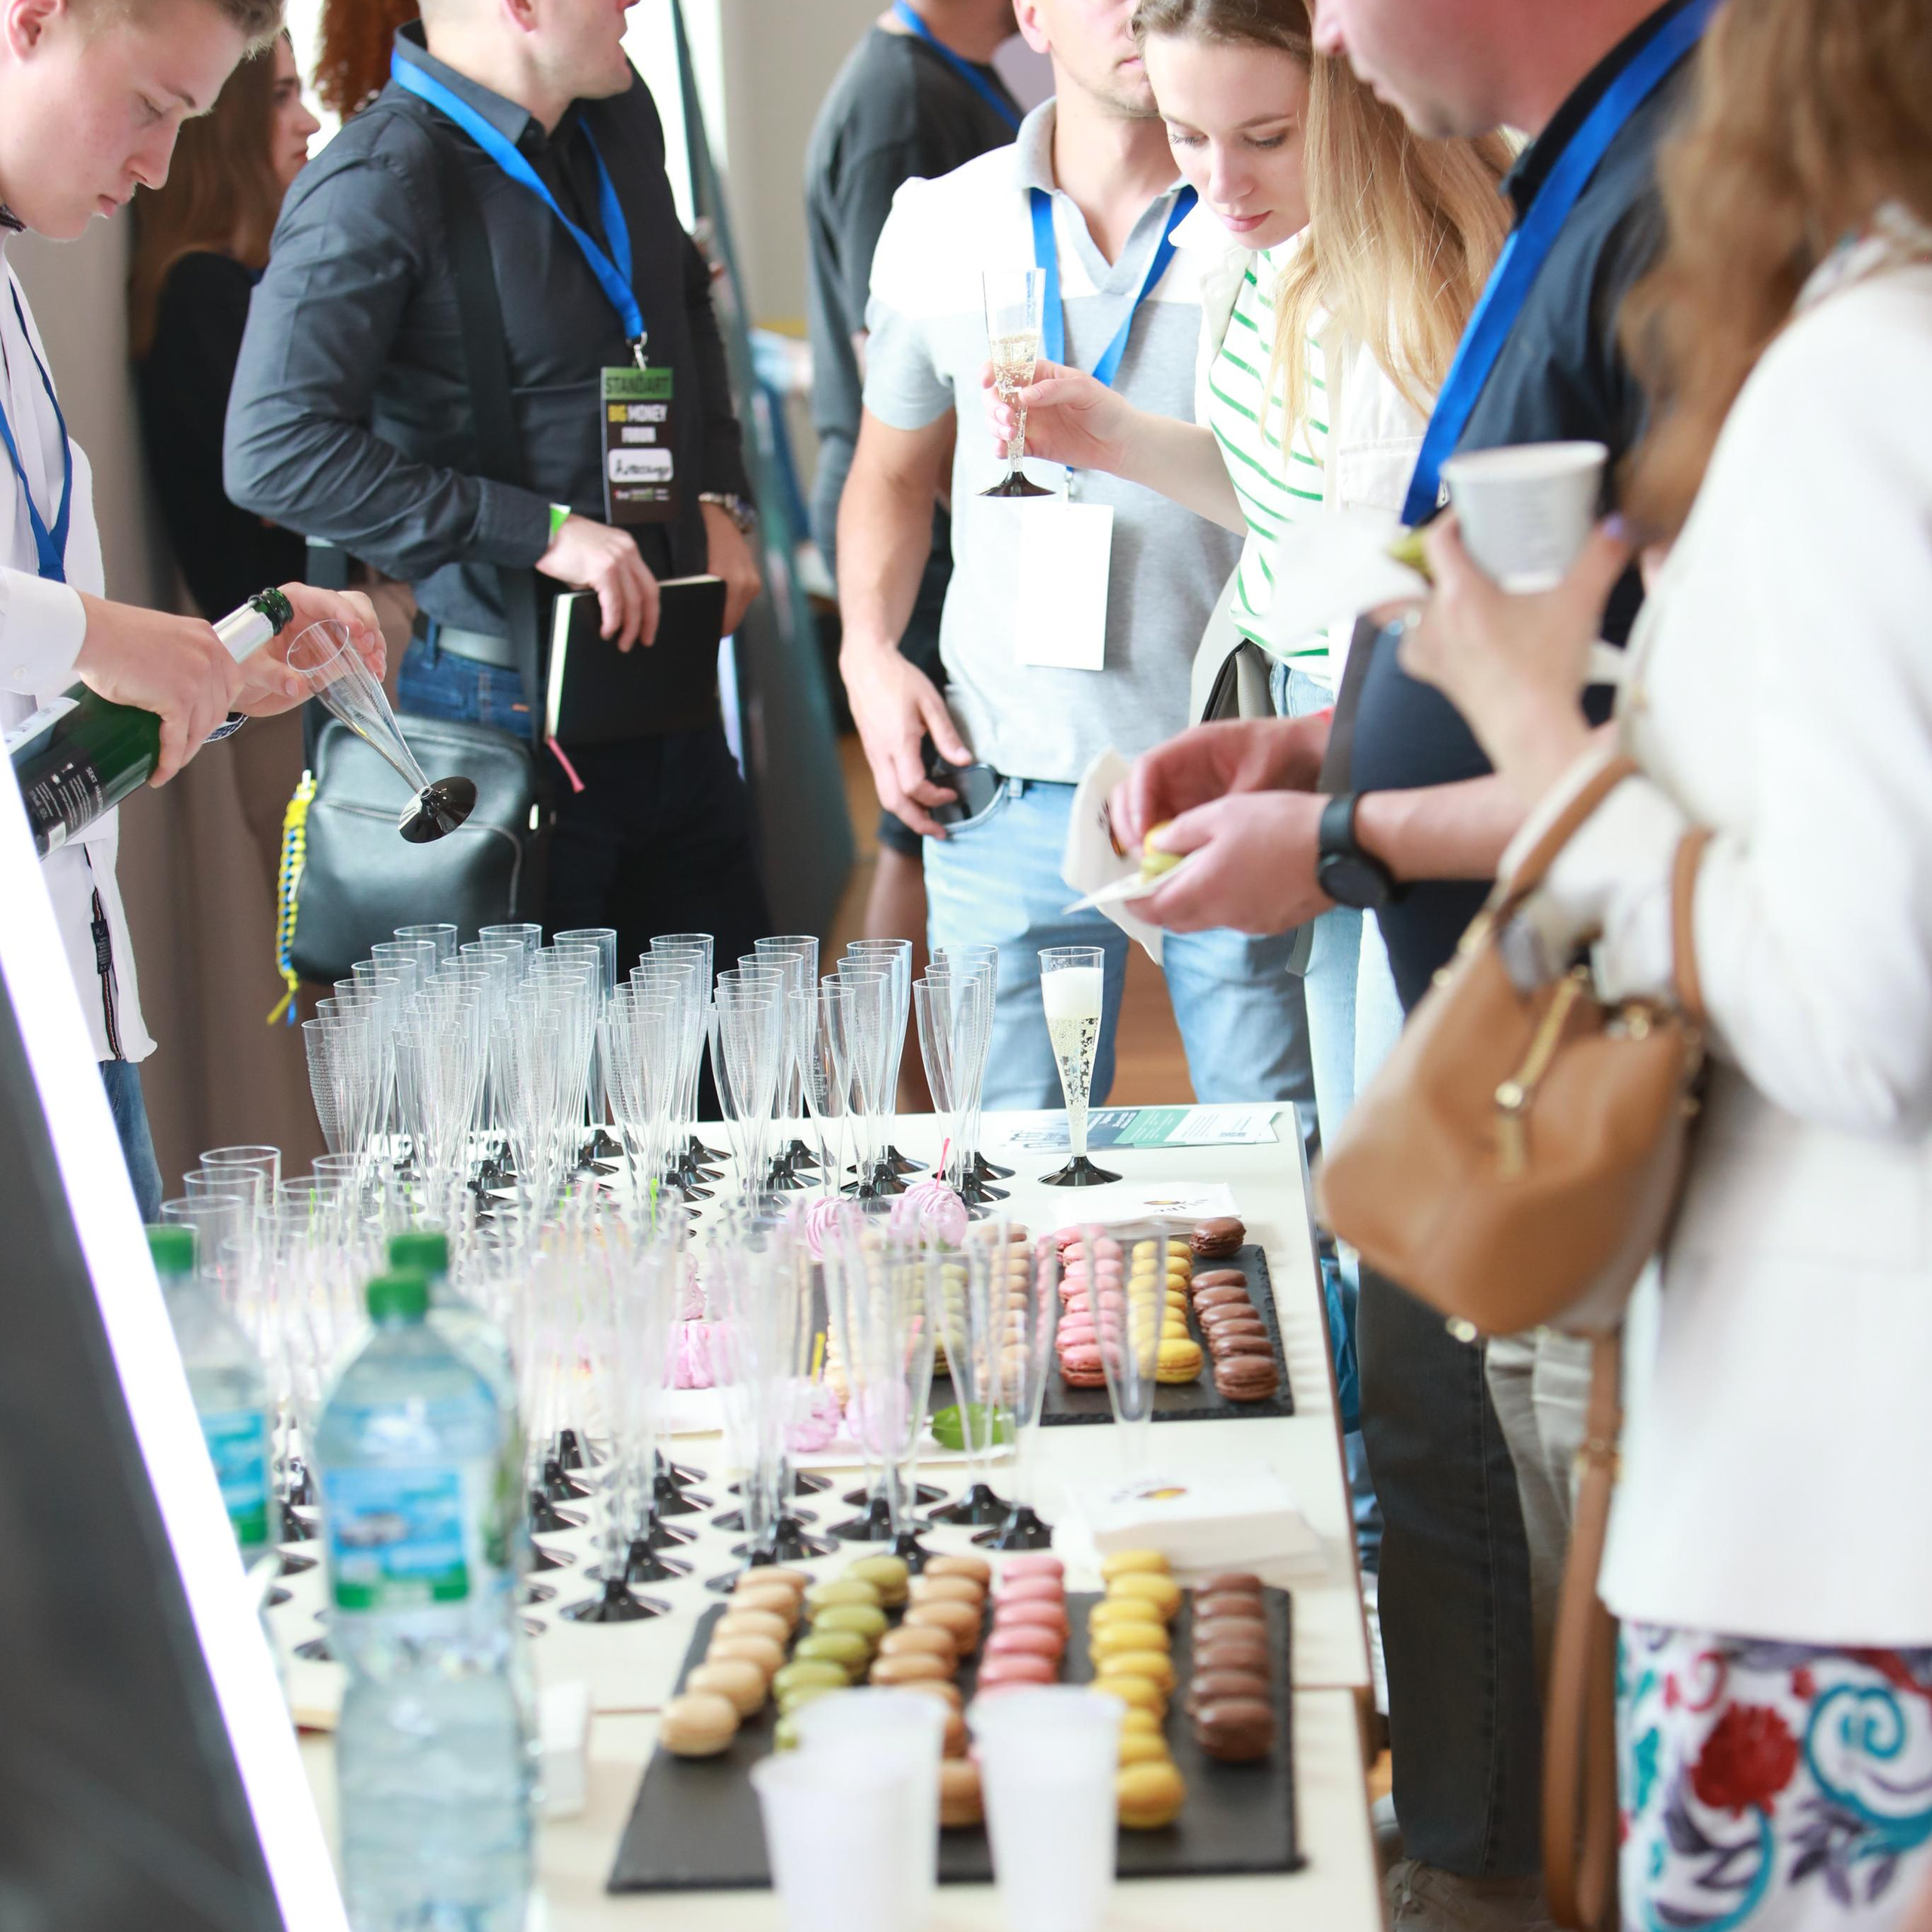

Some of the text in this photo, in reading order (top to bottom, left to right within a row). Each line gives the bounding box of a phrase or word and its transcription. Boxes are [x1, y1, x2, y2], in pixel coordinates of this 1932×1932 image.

[606, 376, 669, 395] STANDART
[628, 404, 668, 423] MONEY
[85, 765, 98, 783] SEKT
